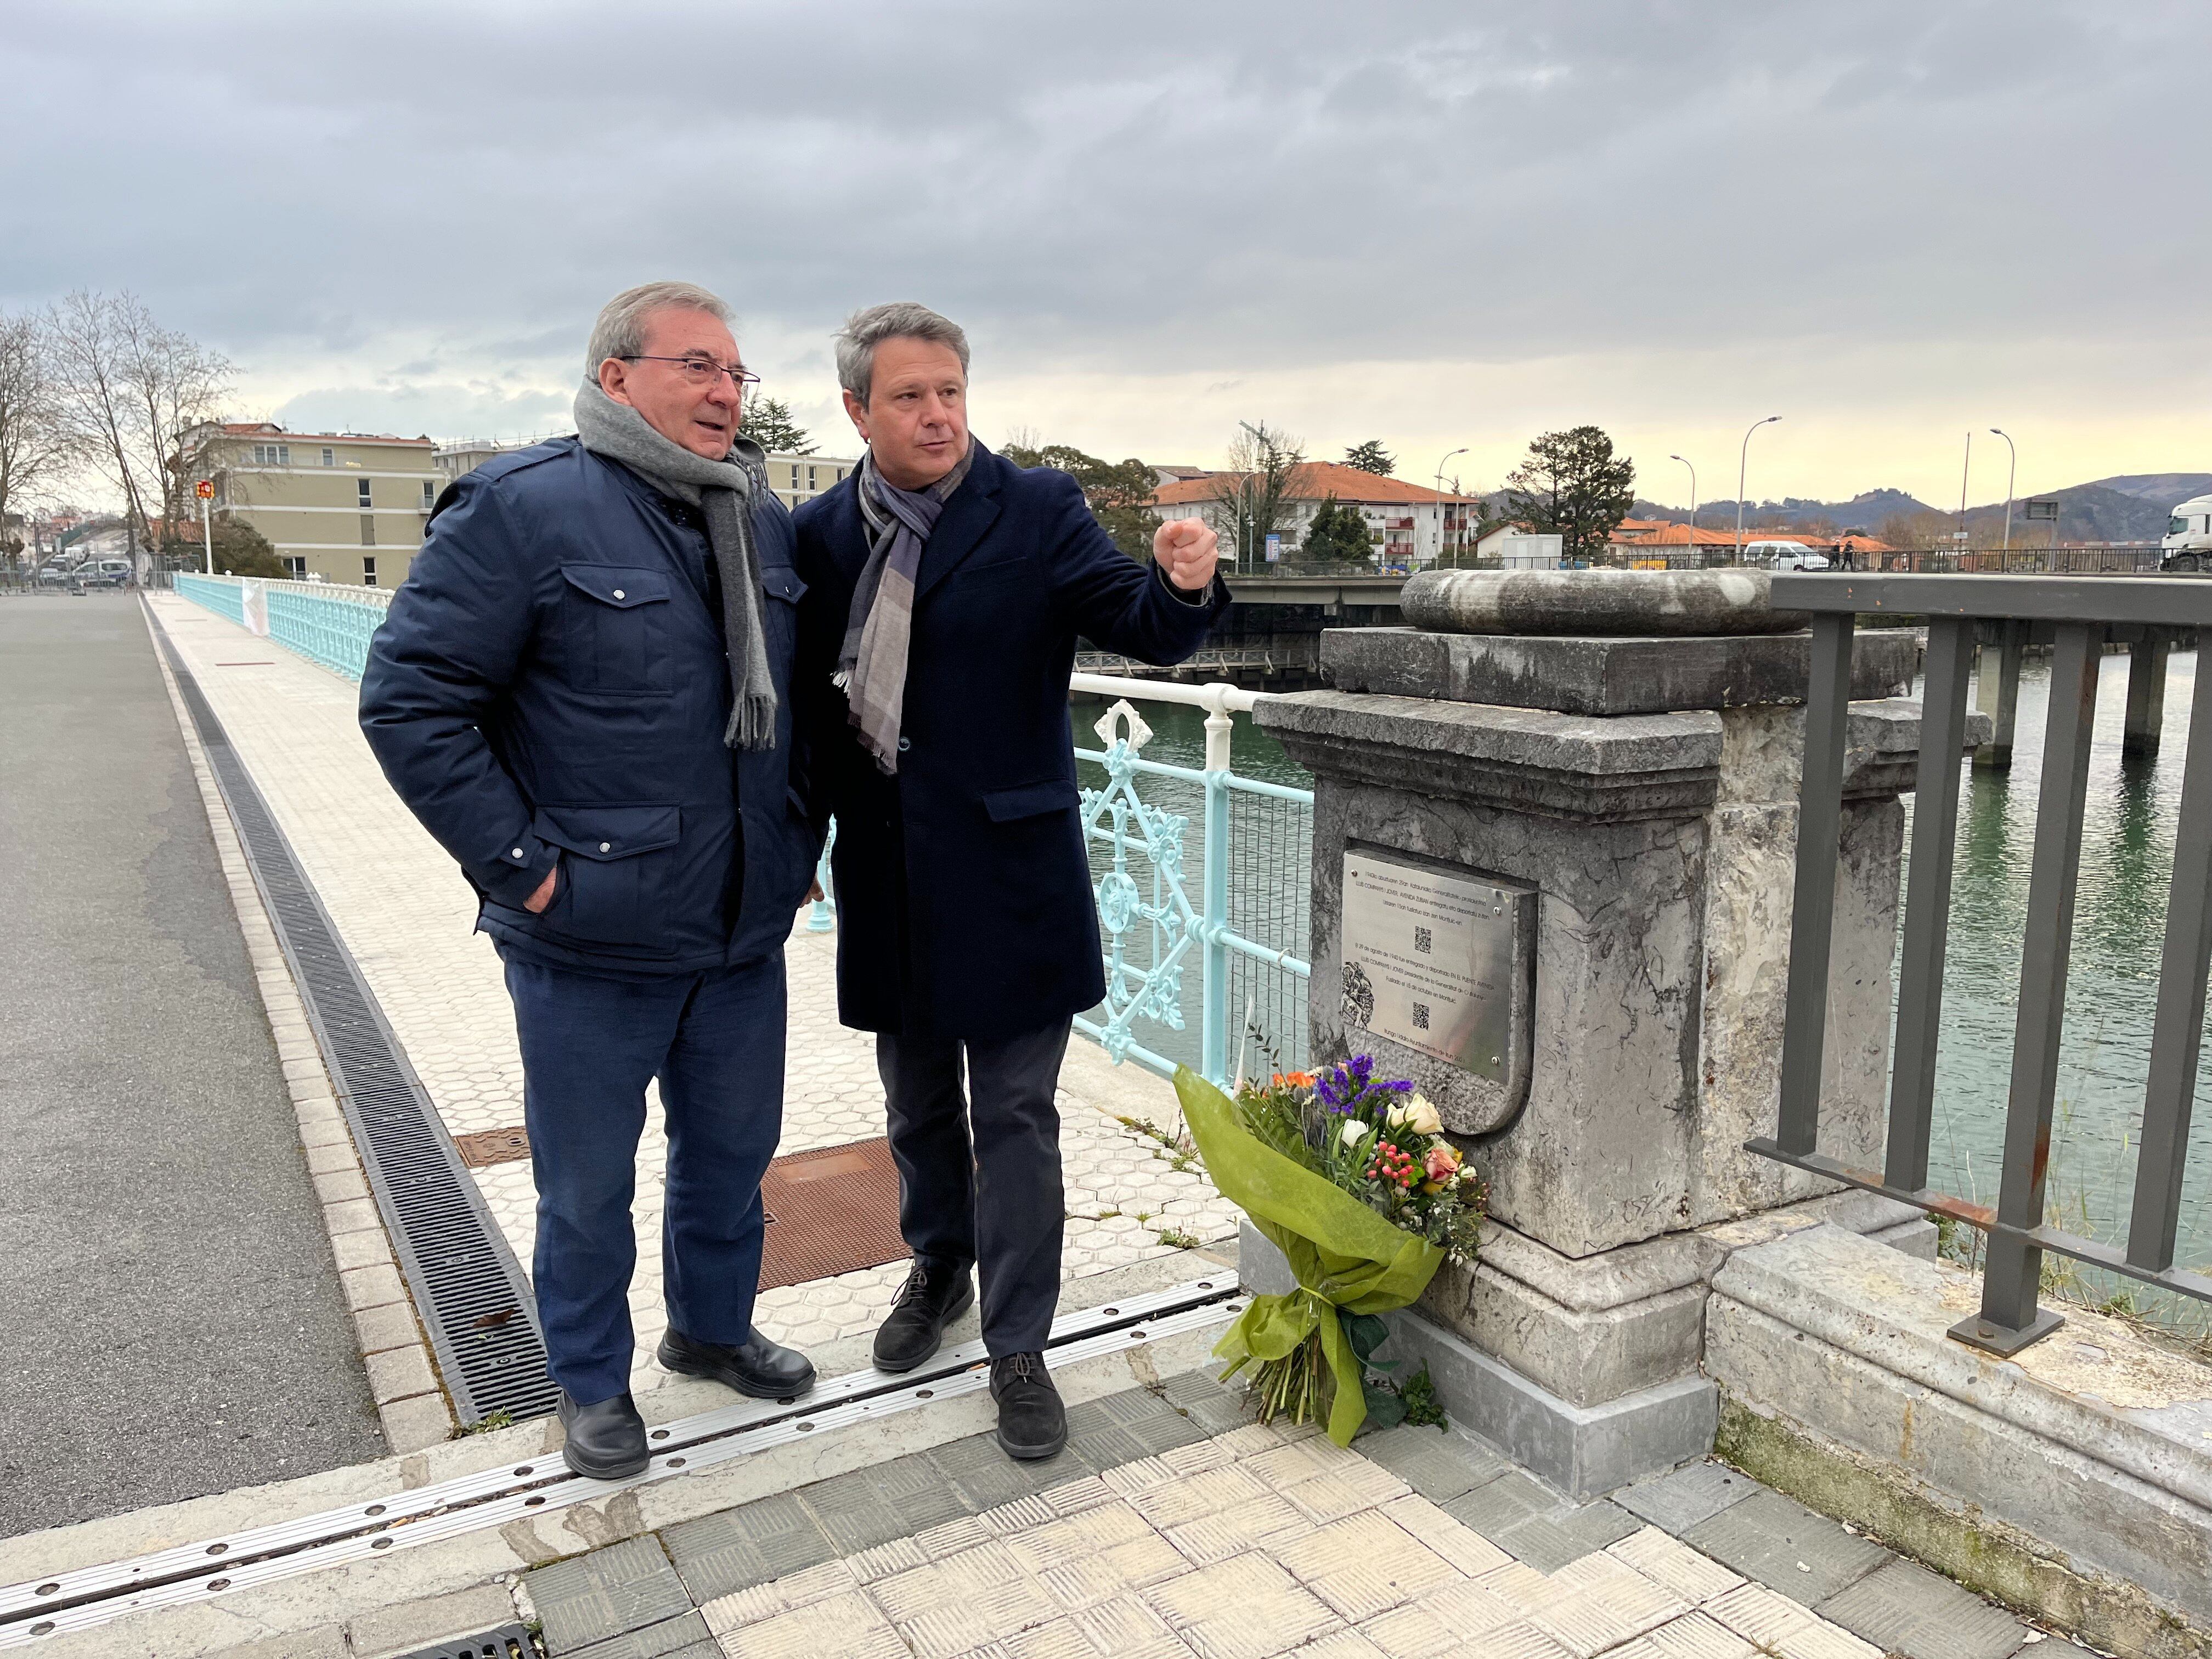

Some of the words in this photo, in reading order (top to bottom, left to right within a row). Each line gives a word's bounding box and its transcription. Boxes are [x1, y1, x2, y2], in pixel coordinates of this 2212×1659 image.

[1364, 883, 1384, 893] COMPANYS
[1400, 892, 1415, 900] AVENIDA
[1457, 907, 1477, 917] deportatu
[1370, 959, 1390, 969] COMPANYS
[1404, 970, 1424, 980] presidente
[1435, 980, 1457, 991] Generalitat
[1386, 975, 1401, 985] Fusilado
[1417, 987, 1432, 996] octubre
[1406, 959, 1425, 969] entregado
[1429, 966, 1449, 977] deportado
[1462, 976, 1476, 986] PUENTE
[1445, 1051, 1453, 1059] Irun
